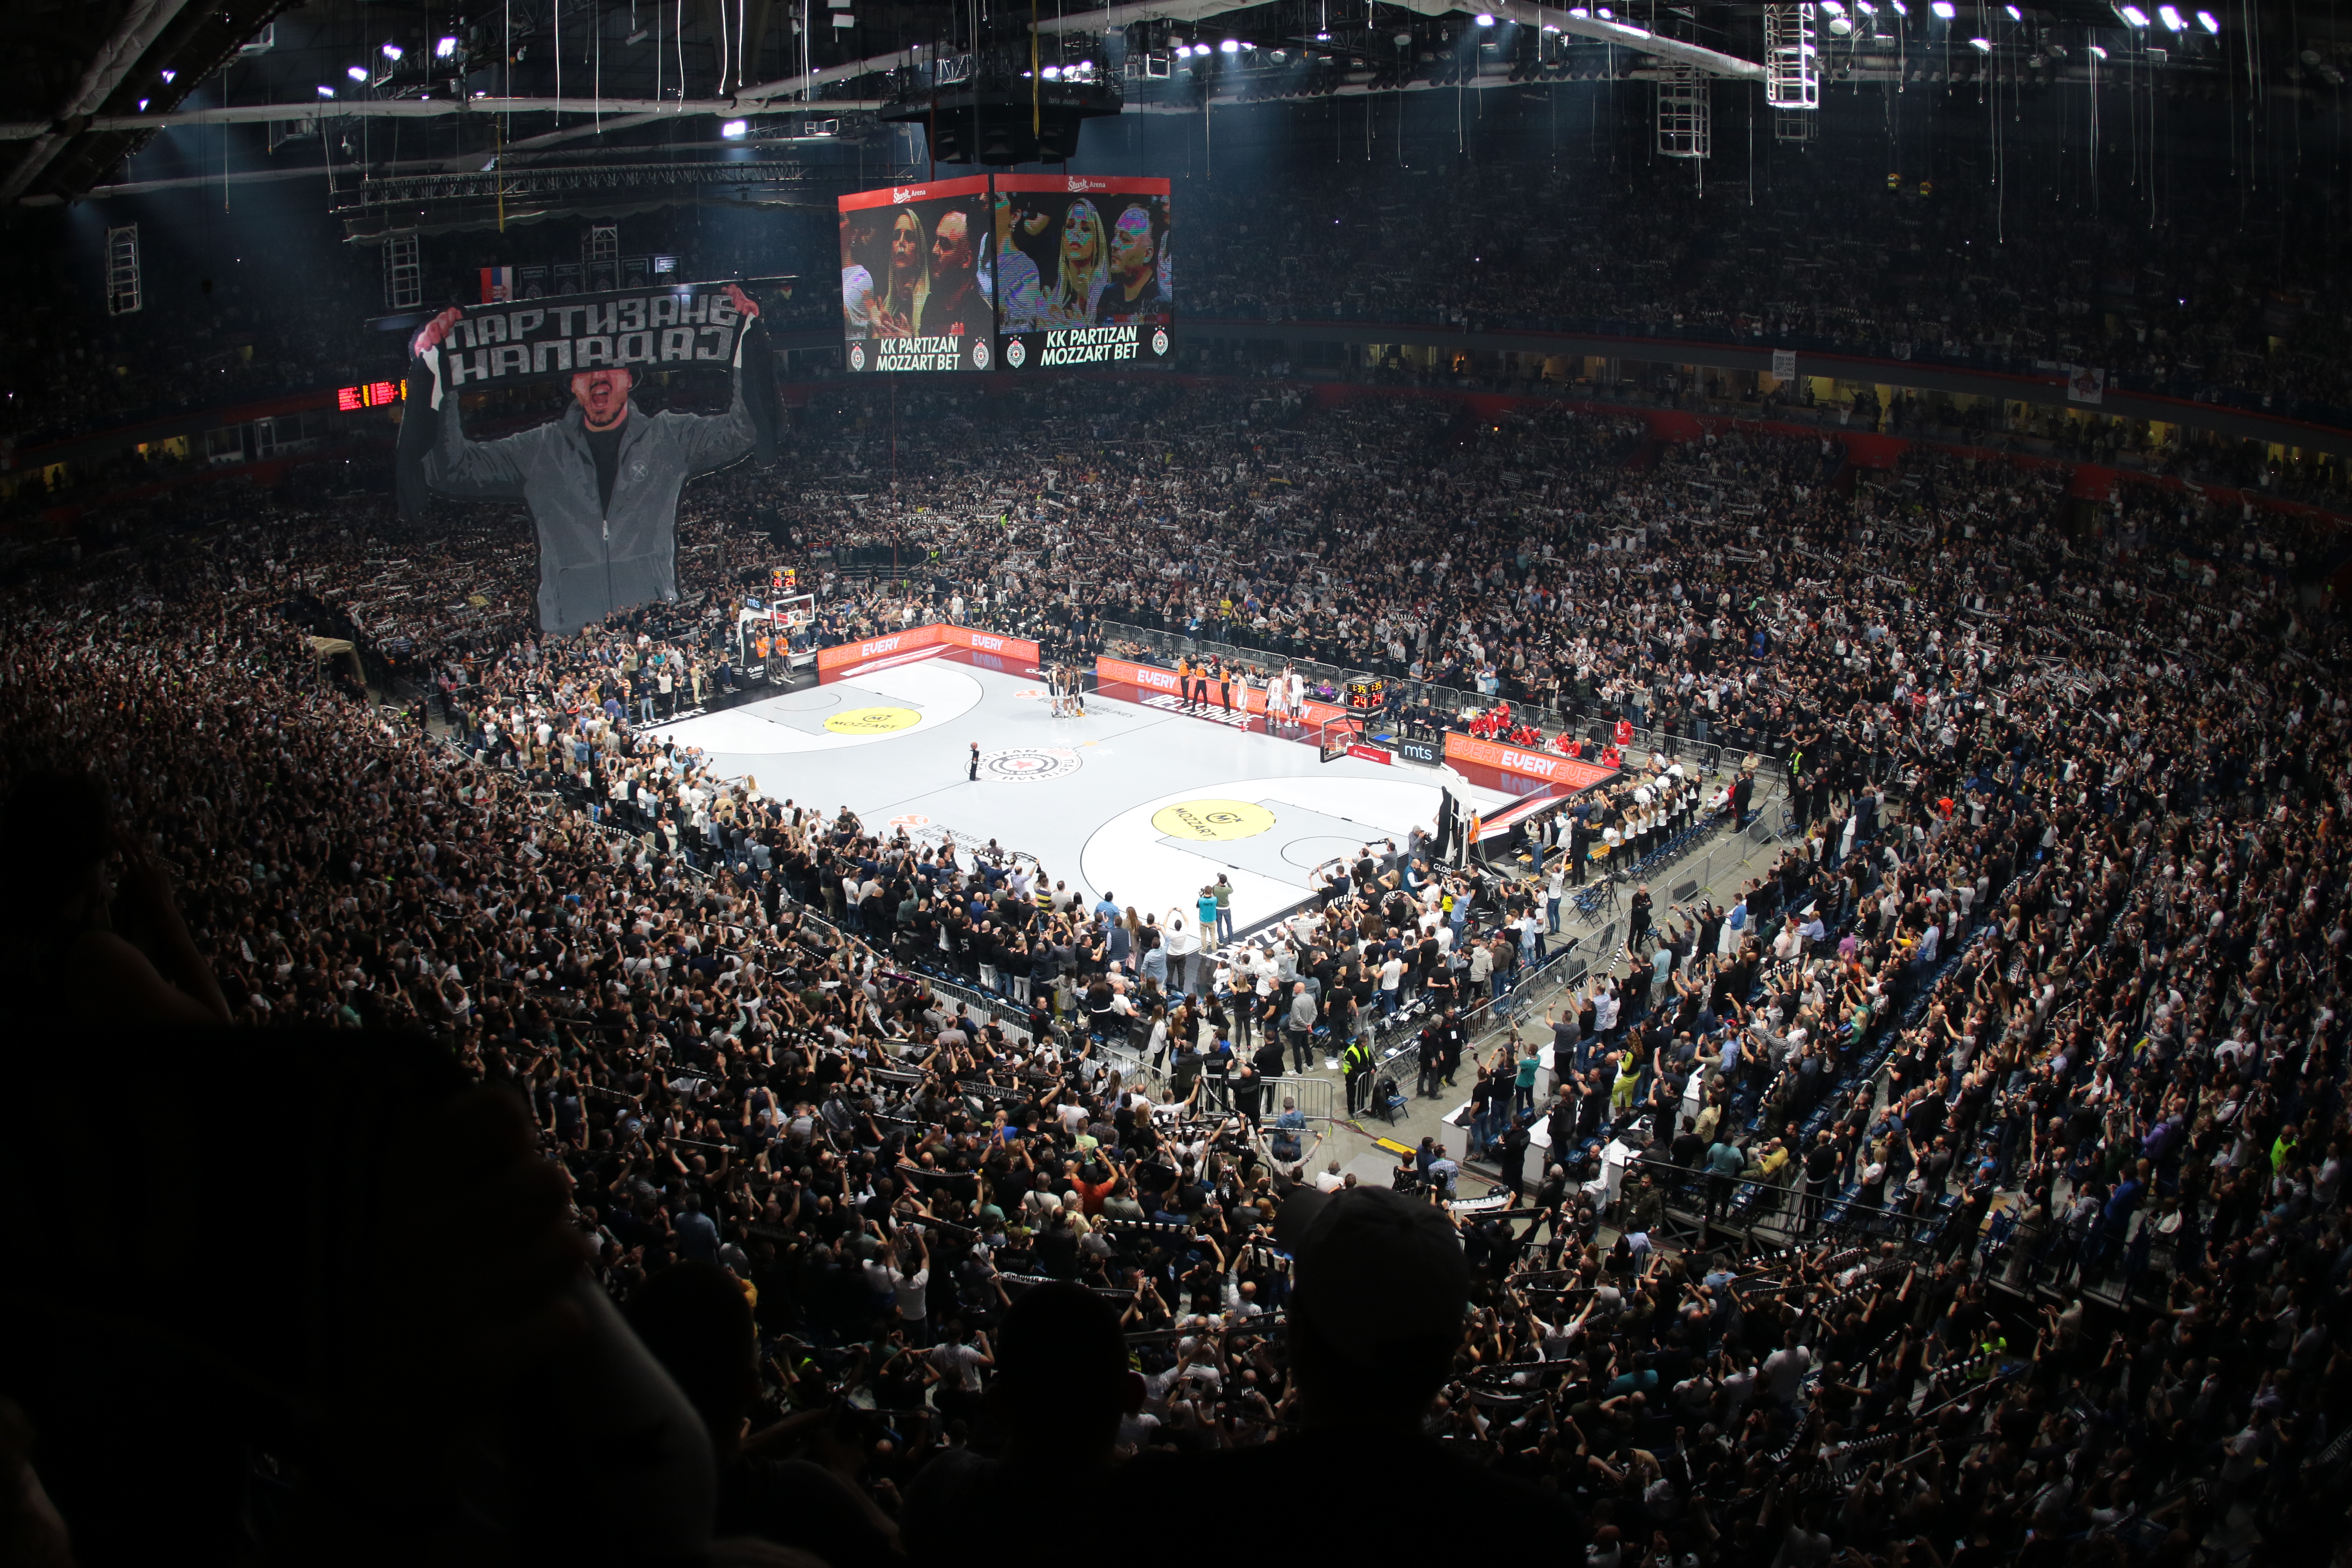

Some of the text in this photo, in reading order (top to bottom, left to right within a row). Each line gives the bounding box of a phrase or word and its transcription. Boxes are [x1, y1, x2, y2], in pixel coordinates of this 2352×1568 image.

[446, 294, 738, 349] ПАРТИЗАНЕ
[881, 336, 958, 354] KK PARTIZAN
[1046, 330, 1067, 348] KK
[1069, 325, 1137, 346] PARTIZAN
[449, 326, 733, 386] НАПАДАЈ
[876, 354, 935, 371] MOZZART
[937, 354, 961, 371] BET
[1041, 344, 1112, 366] MOZZART
[1114, 342, 1139, 360] BET
[774, 579, 781, 587] 24
[785, 577, 795, 586] 24
[747, 598, 760, 608] mts
[822, 645, 863, 666] EVERY
[861, 636, 900, 657] EVERY
[900, 628, 937, 648] EVERY
[943, 628, 1036, 658] EVERY EVERY EVERY
[1100, 661, 1139, 681] EVERY
[1137, 669, 1177, 689] EVERY
[1353, 684, 1366, 694] 1:35
[1372, 681, 1382, 691] 1:35
[1354, 695, 1366, 708] 24
[1372, 693, 1382, 706] 24
[1091, 705, 1136, 718] AIRLINES
[1404, 744, 1433, 760] mts
[1449, 738, 1504, 763] EVERY
[1501, 750, 1558, 776] EVERY
[1172, 808, 1217, 836] MOZZART
[931, 824, 983, 845] TURKISH
[1433, 863, 1456, 874] GLOB
